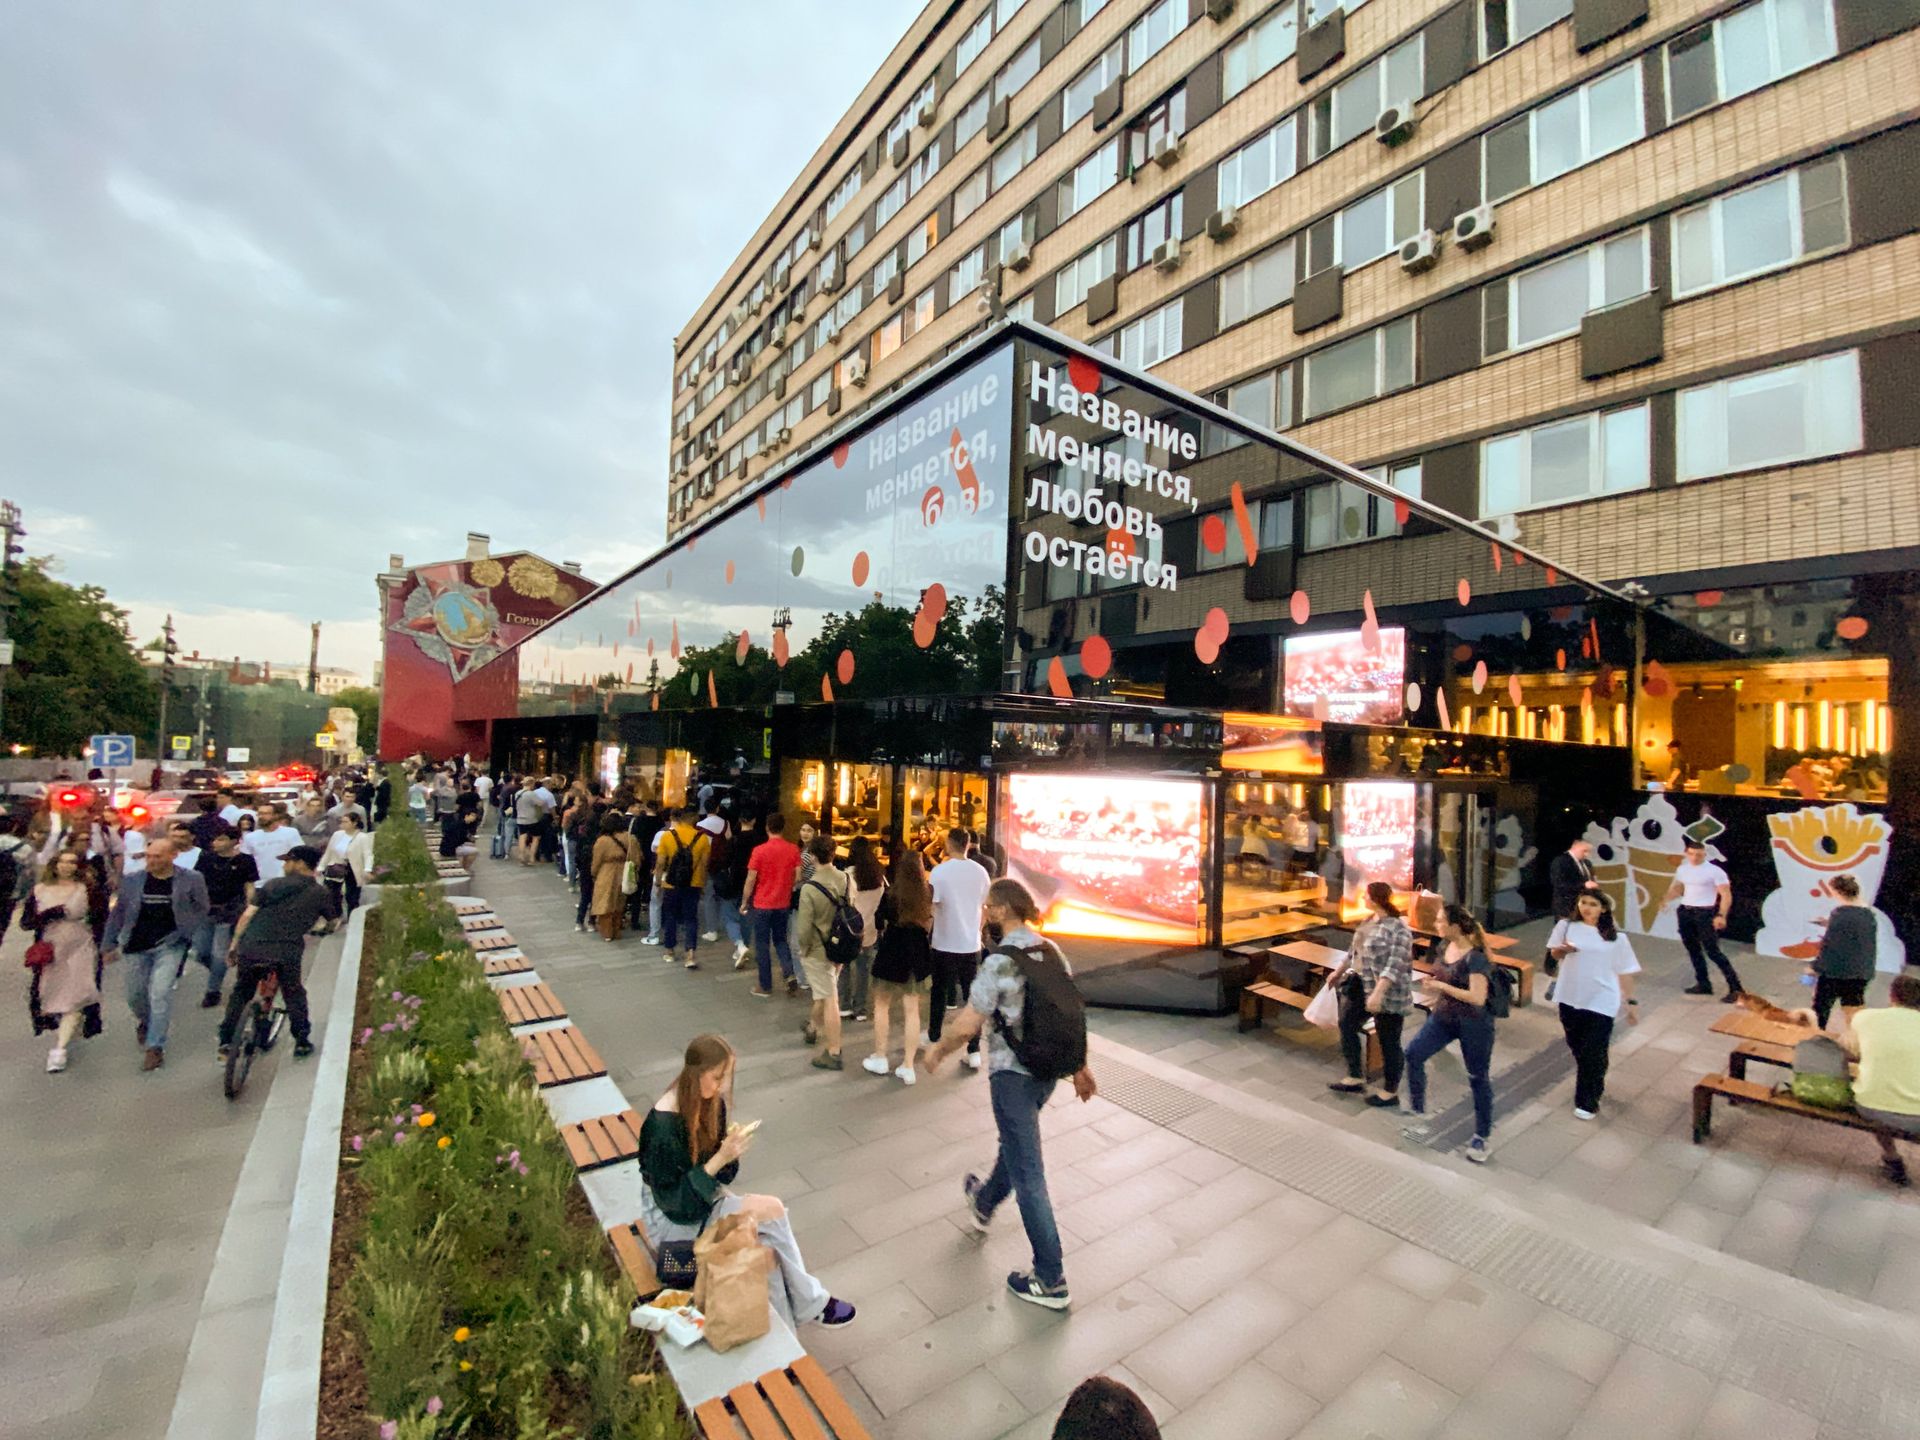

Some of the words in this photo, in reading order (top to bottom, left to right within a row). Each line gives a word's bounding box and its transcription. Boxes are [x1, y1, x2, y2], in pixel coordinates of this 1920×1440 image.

[869, 373, 999, 471] Название
[1030, 360, 1197, 459] Название
[865, 428, 997, 513] меняется,
[1026, 478, 1163, 541] любовь
[1028, 423, 1198, 513] меняется,
[1025, 530, 1178, 591] остаётся
[103, 740, 127, 764] P
